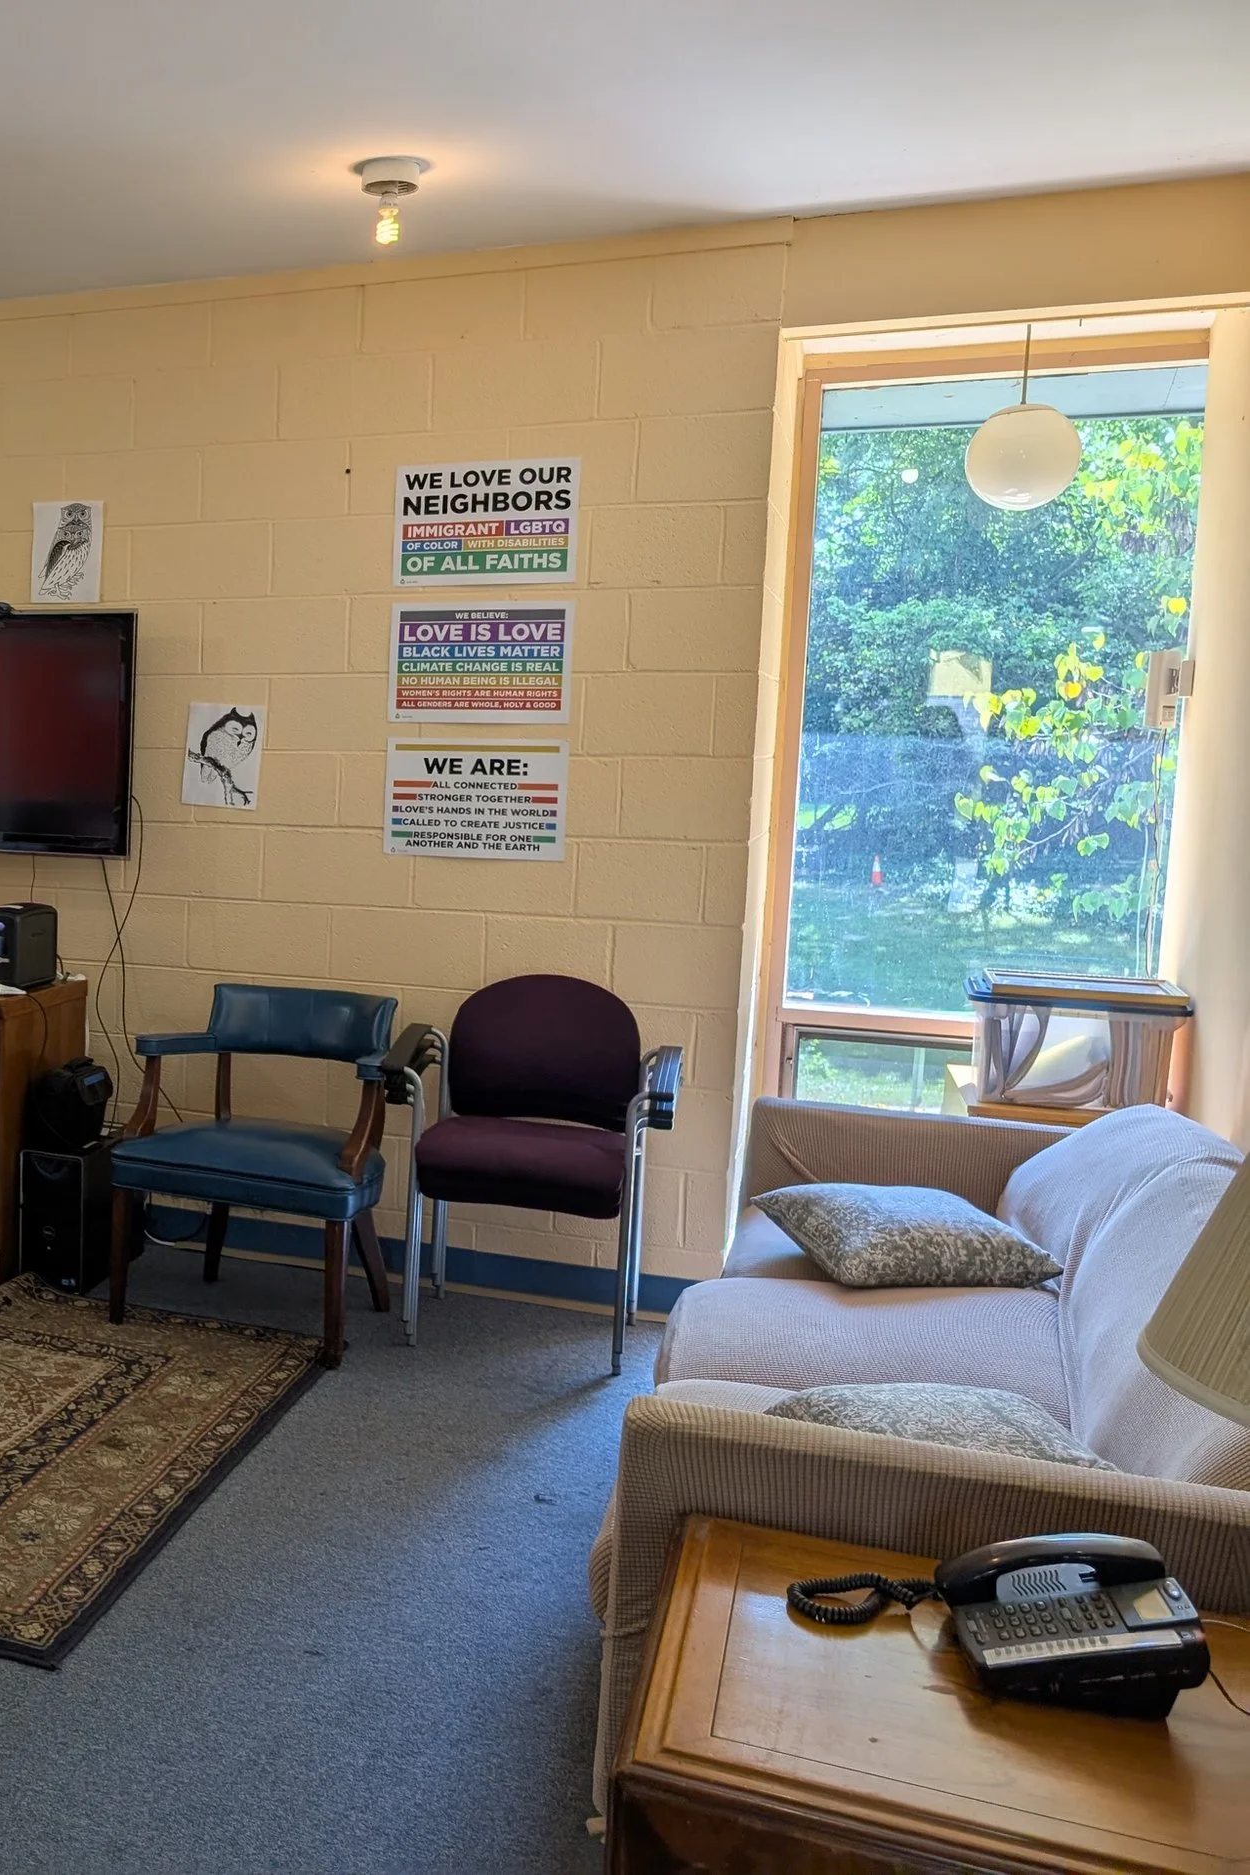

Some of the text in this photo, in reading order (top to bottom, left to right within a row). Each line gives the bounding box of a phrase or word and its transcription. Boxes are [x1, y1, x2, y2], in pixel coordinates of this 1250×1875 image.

[405, 466, 572, 490] WE LOVE OUR
[403, 489, 571, 516] NEIGHBORS
[407, 520, 565, 538] IMMIGRANT LGBTQ
[406, 537, 564, 551] OF COLOR WITH DISABILITIES
[406, 552, 562, 572] OF ALL FAITHS
[403, 623, 562, 642] LOVE IS LOVE
[402, 646, 560, 658] BLACK LIVES MATTER
[402, 662, 559, 672] CLIMATE CHANGE IS REAL
[401, 677, 558, 686] NO HUMAN BEING IS ILLEGAL
[526, 690, 558, 698] RIGHTS
[471, 701, 502, 709] WHOLE,
[423, 757, 528, 776] WE ARE:
[432, 781, 518, 790] ALL CONNECTED
[418, 793, 531, 804] STRONGER TOGETHER
[399, 805, 550, 817] LOVE'S HANDS IN THE WORLD
[402, 818, 545, 830] CALLED TO CREATE JUSTICE
[413, 831, 532, 842] RESPONSIBLE FOR ONE
[405, 840, 540, 852] ANOTHER AND THE EARTH
